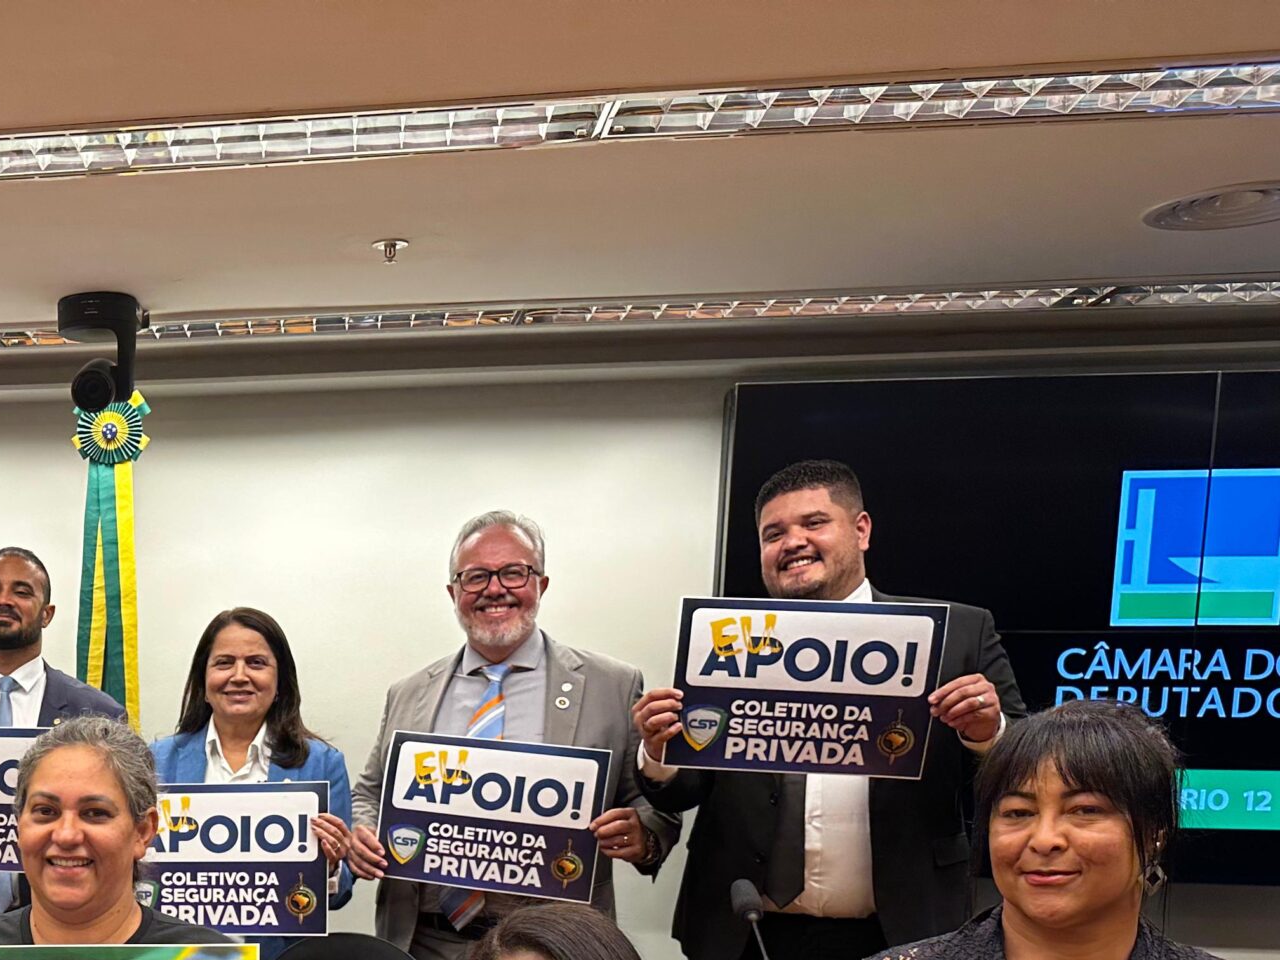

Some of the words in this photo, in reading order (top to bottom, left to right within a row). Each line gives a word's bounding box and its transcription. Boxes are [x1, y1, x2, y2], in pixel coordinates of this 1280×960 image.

[710, 614, 783, 657] EU
[699, 635, 918, 687] APOIO!
[1056, 641, 1231, 680] CÂMARA
[1243, 648, 1280, 680] D
[730, 699, 838, 721] COLETIVO
[844, 705, 872, 722] DA
[689, 719, 718, 730] CSP
[728, 718, 870, 744] SEGURANÇA
[724, 737, 865, 766] PRIVADA
[414, 750, 471, 785] EU
[403, 767, 584, 820] APOIO!
[1243, 790, 1272, 812] 12
[394, 836, 418, 847] CSP
[428, 823, 517, 844] COLETIVO
[522, 834, 547, 849] DA
[426, 838, 545, 867] SEGURANÇA
[161, 872, 249, 885] COLETIVO
[255, 872, 279, 885] DA
[424, 855, 541, 888] PRIVADA
[161, 888, 279, 906] SEGURANÇA
